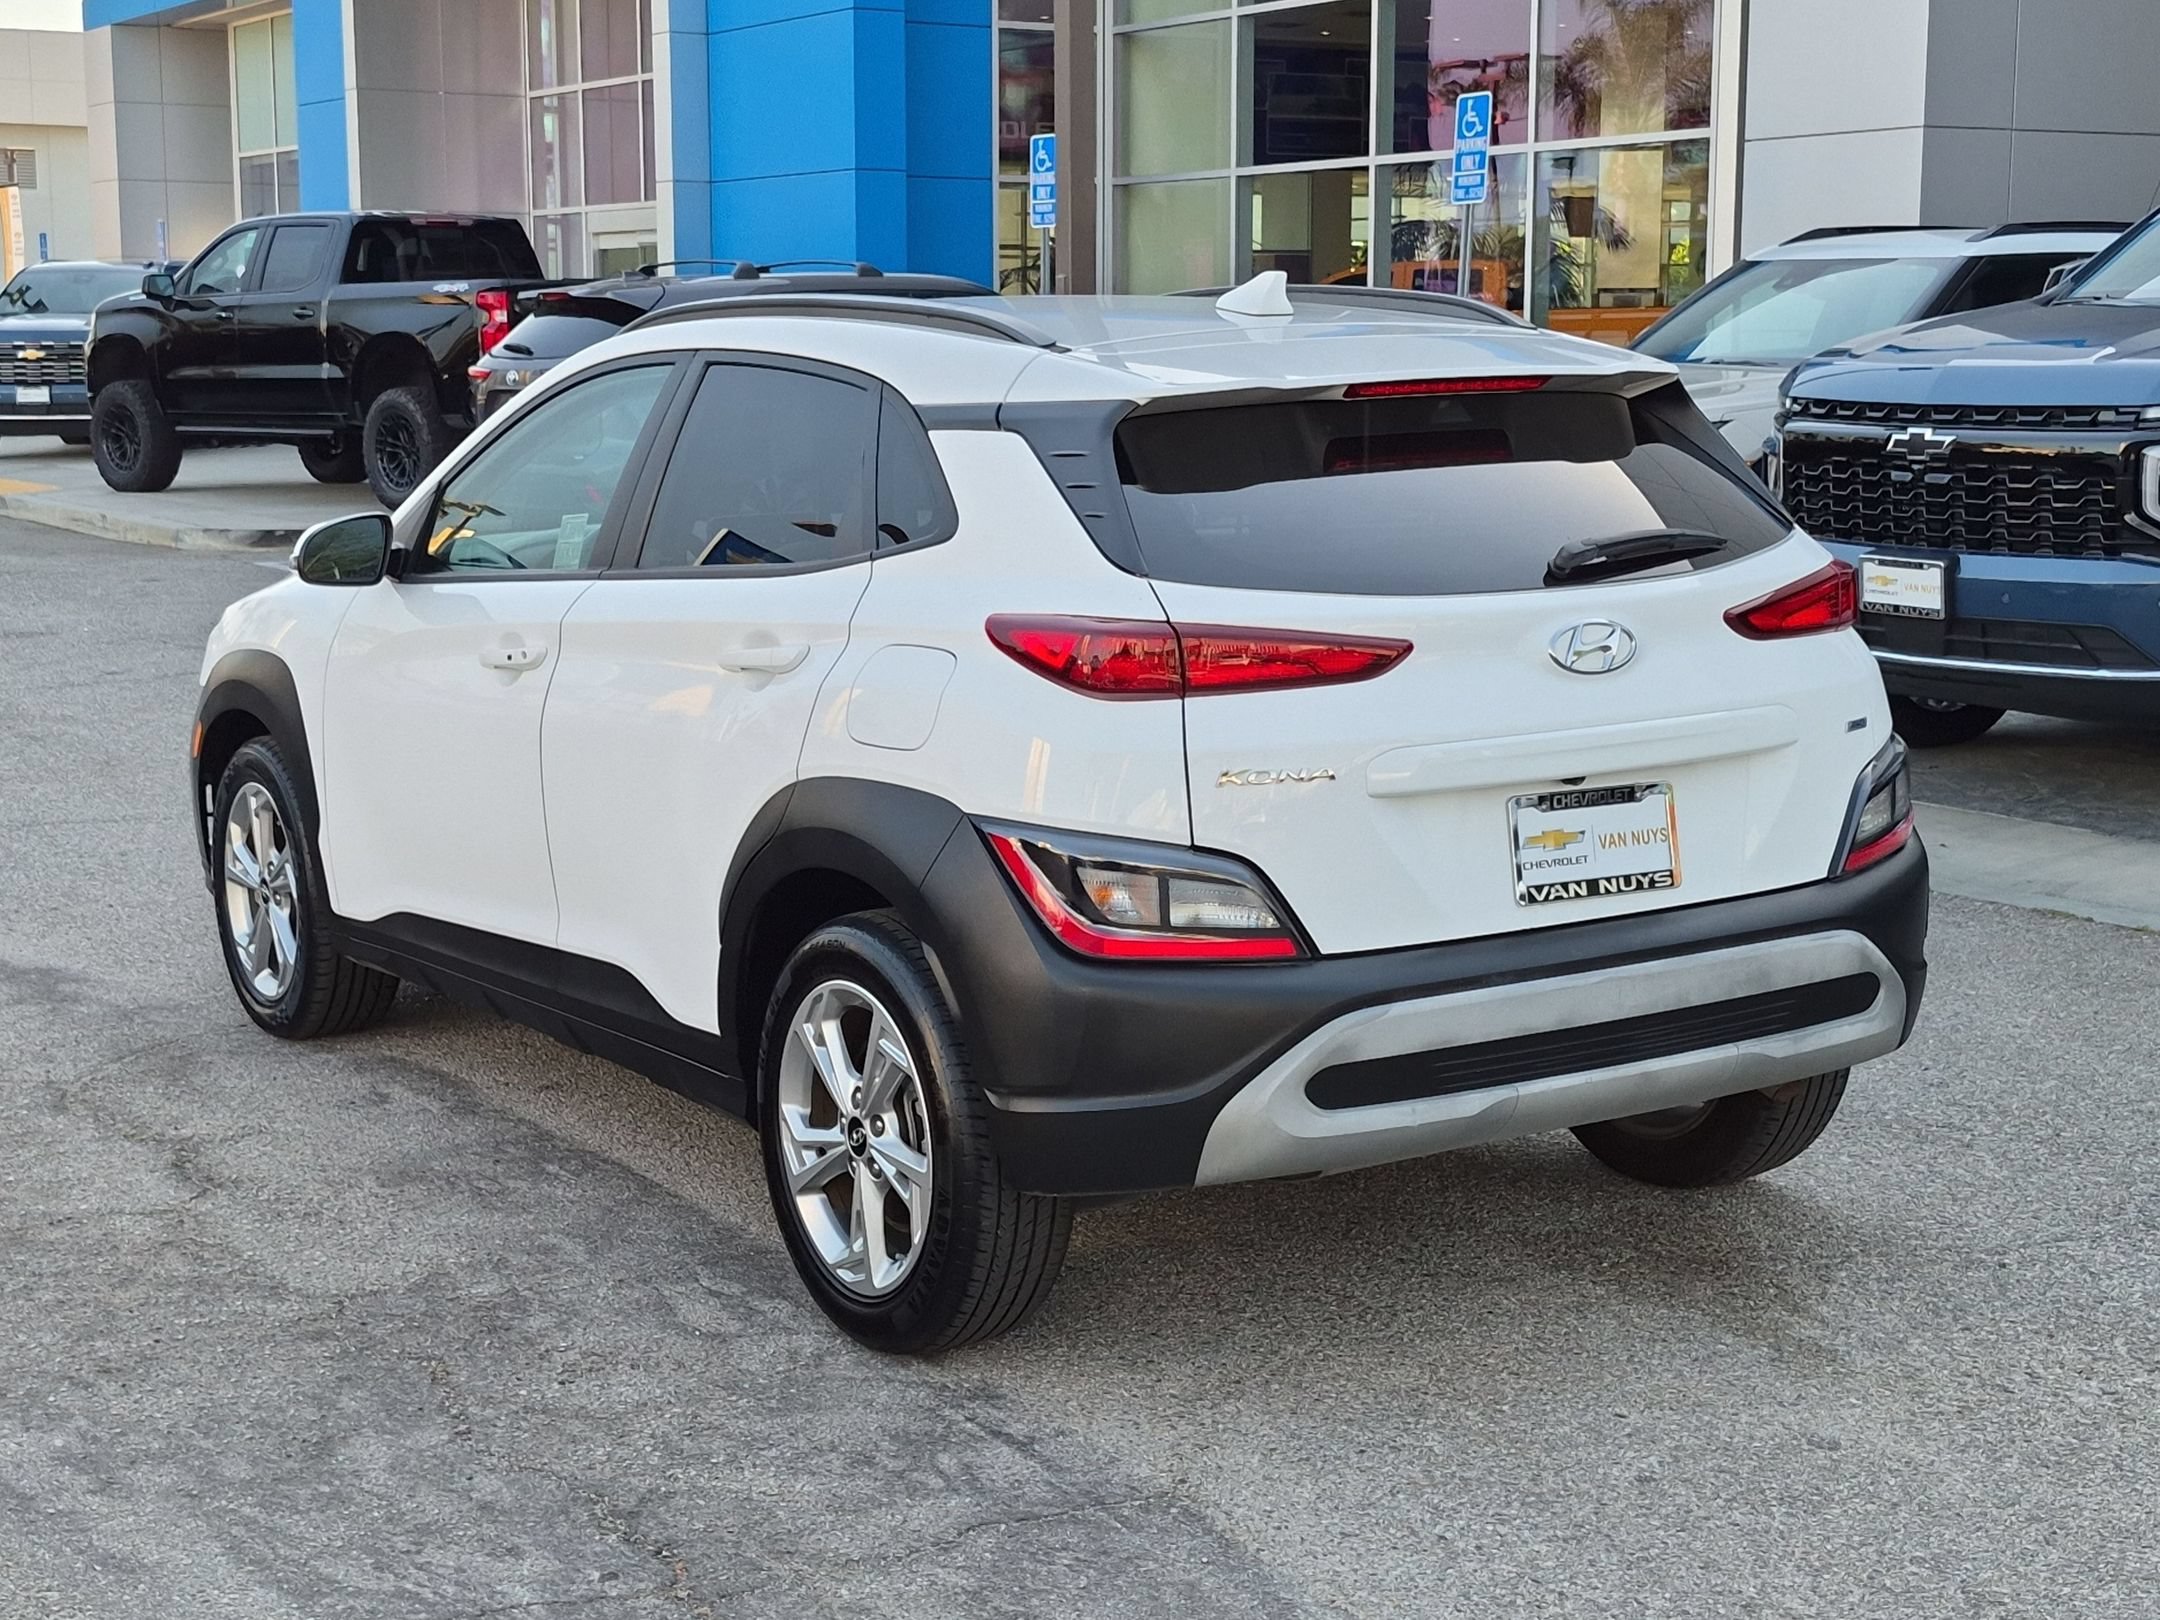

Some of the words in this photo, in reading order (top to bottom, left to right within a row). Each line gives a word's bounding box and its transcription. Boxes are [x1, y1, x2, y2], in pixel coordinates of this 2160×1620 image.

[1461, 154, 1480, 171] ONLY
[1904, 583, 1919, 593] VAN
[1865, 602, 1894, 612] VAN
[1899, 606, 1939, 618] NUYS
[1216, 768, 1336, 787] KONA
[1553, 788, 1631, 808] CHEVROLET
[1598, 831, 1627, 850] VAN
[1631, 827, 1668, 846] NUYS
[1522, 855, 1589, 871] CHEVROLET
[1529, 881, 1588, 901] VAN
[1600, 871, 1673, 894] NUYS
